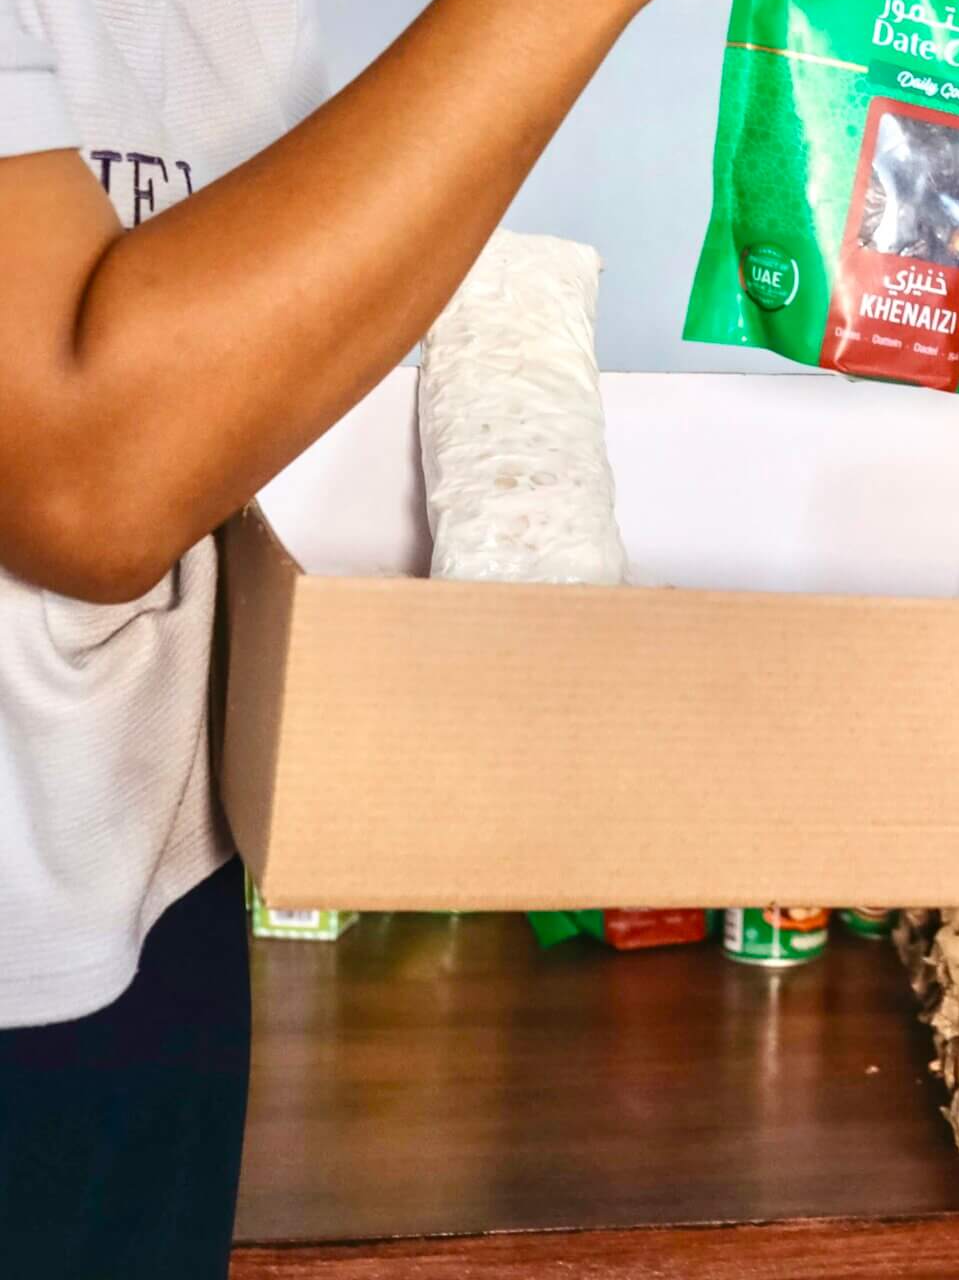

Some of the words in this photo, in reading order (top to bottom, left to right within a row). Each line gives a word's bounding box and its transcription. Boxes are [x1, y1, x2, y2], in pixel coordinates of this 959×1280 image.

[872, 17, 936, 60] Date
[897, 70, 938, 97] Daily
[752, 266, 783, 289] UAE
[859, 293, 957, 336] KHENAIZI
